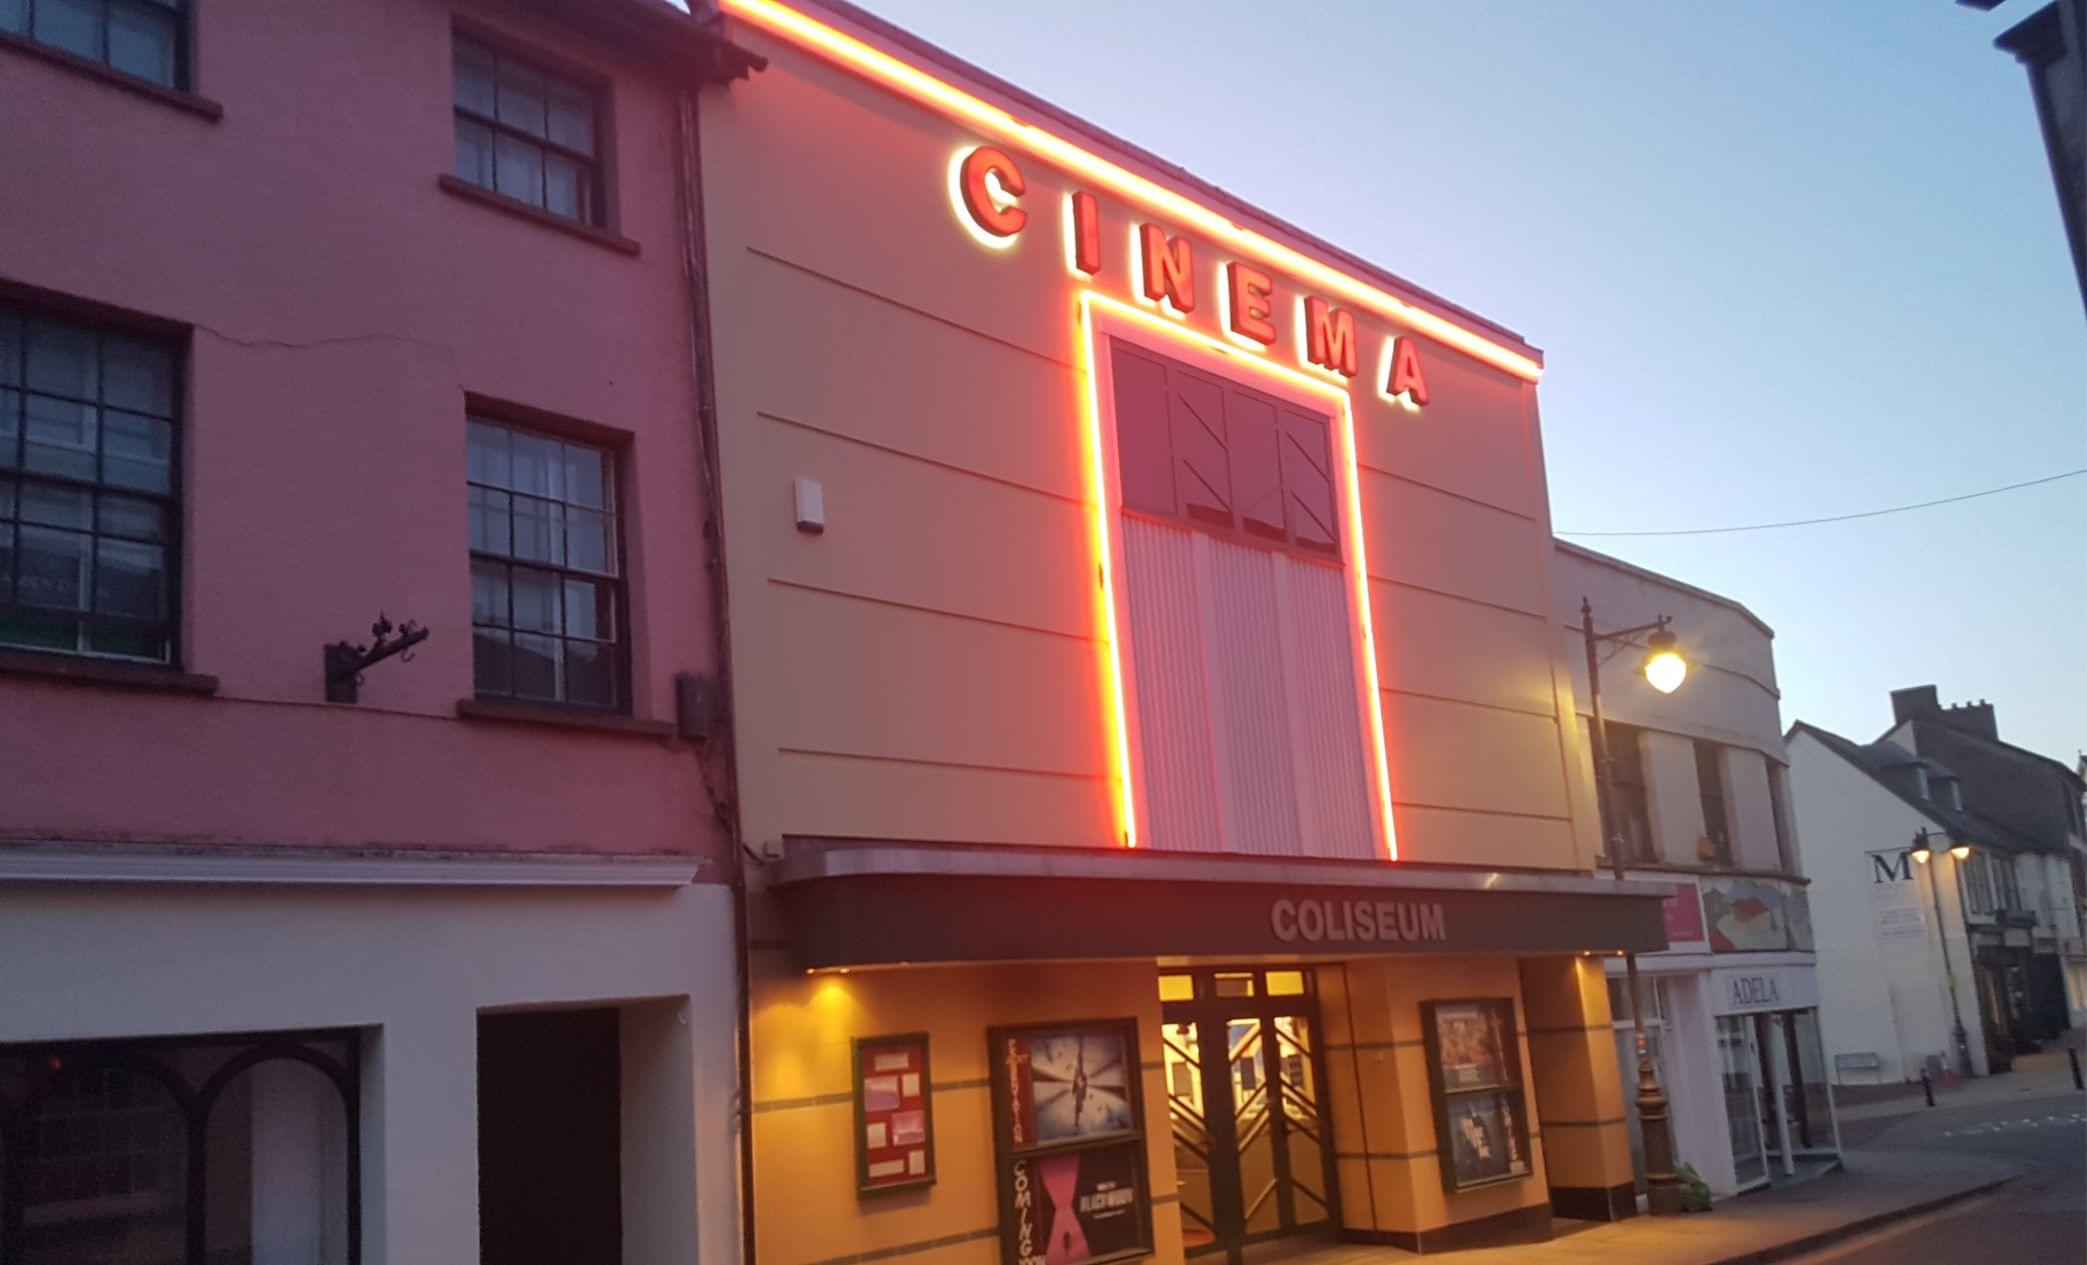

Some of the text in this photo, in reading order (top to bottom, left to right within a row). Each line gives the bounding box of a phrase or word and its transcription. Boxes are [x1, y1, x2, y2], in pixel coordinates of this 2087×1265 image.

[950, 144, 1429, 408] CINEMA
[1871, 851, 1914, 884] M
[1270, 899, 1446, 942] COLISEUM
[1731, 976, 1780, 1006] ADELA
[1014, 1160, 1032, 1257] COMING
